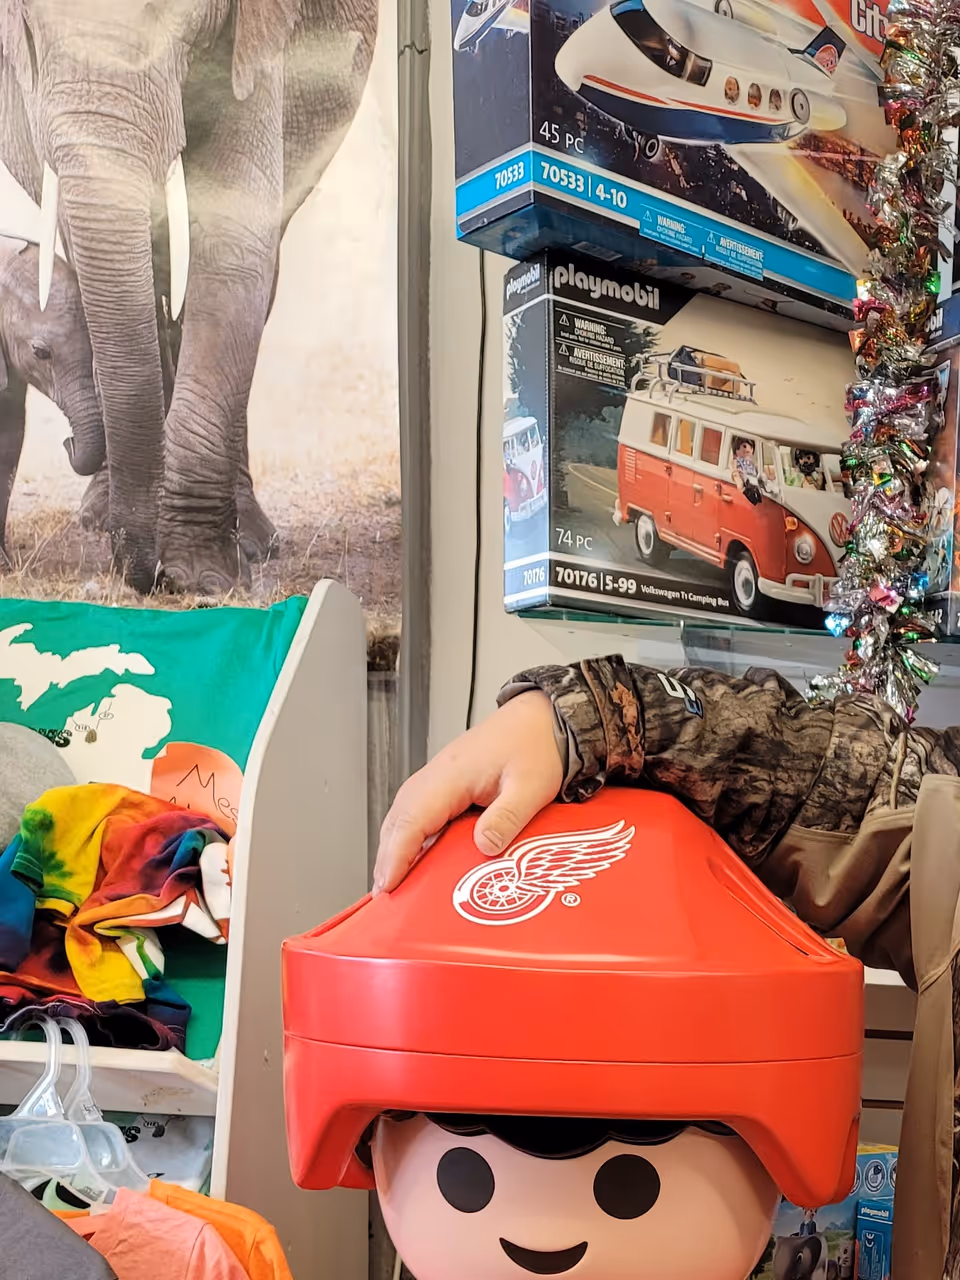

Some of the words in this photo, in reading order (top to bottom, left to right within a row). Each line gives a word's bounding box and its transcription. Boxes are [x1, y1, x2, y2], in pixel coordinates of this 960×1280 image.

[539, 120, 560, 144] 45
[565, 132, 584, 154] PC
[494, 162, 525, 190] 70533
[541, 161, 585, 193] 70533
[595, 183, 627, 209] 4-10
[506, 263, 540, 300] playmobil
[554, 263, 660, 310] playmobil
[574, 318, 607, 334] WARNING:
[573, 348, 626, 369] AVERTISSEMENT:
[555, 528, 573, 547] 74
[576, 535, 593, 550] PC
[523, 567, 545, 585] 70176
[555, 566, 598, 588] 70176
[605, 575, 636, 594] 5-99
[641, 585, 680, 599] Volkswagen
[689, 592, 716, 607] Camping
[718, 599, 729, 607] Bus
[861, 1206, 889, 1218] playmobil
